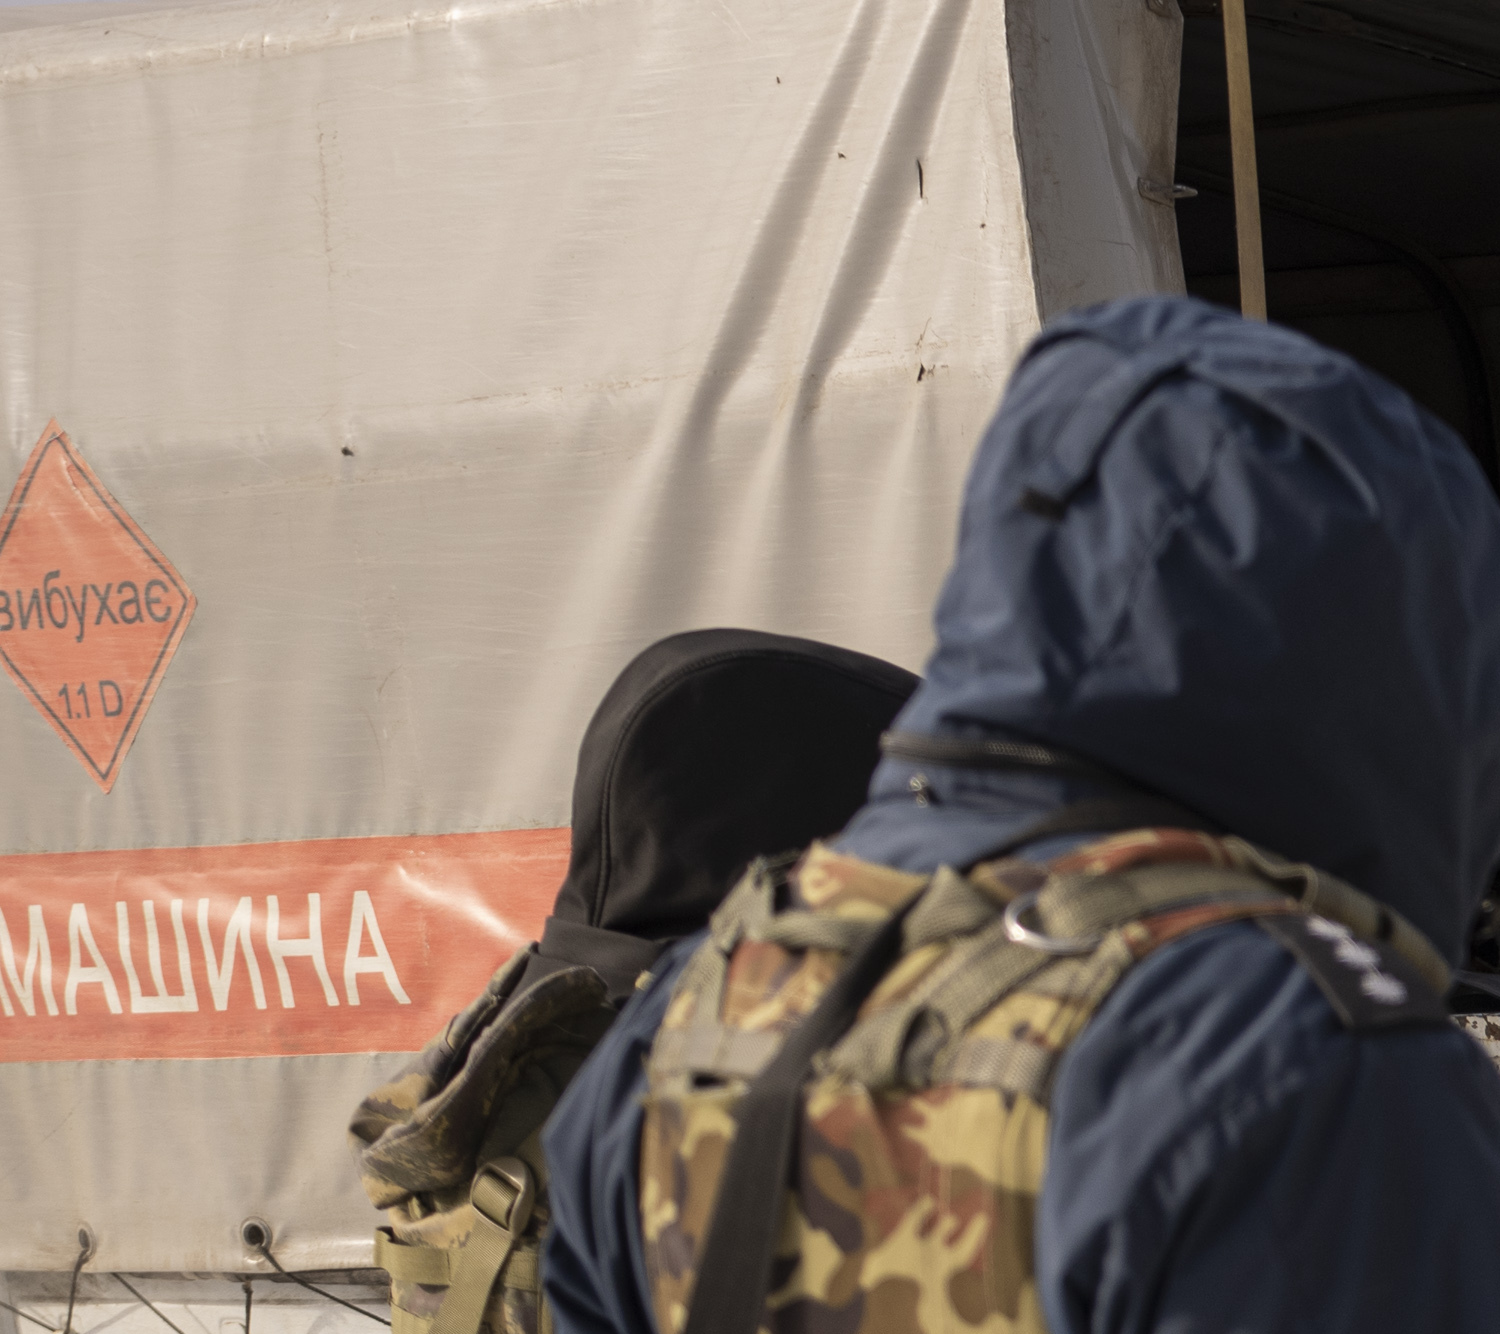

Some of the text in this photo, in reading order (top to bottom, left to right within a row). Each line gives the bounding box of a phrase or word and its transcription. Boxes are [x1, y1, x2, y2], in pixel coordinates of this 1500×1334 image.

[0, 569, 172, 643] вибухає
[58, 680, 124, 719] 1.1 D
[0, 891, 411, 1016] МАШИНА
